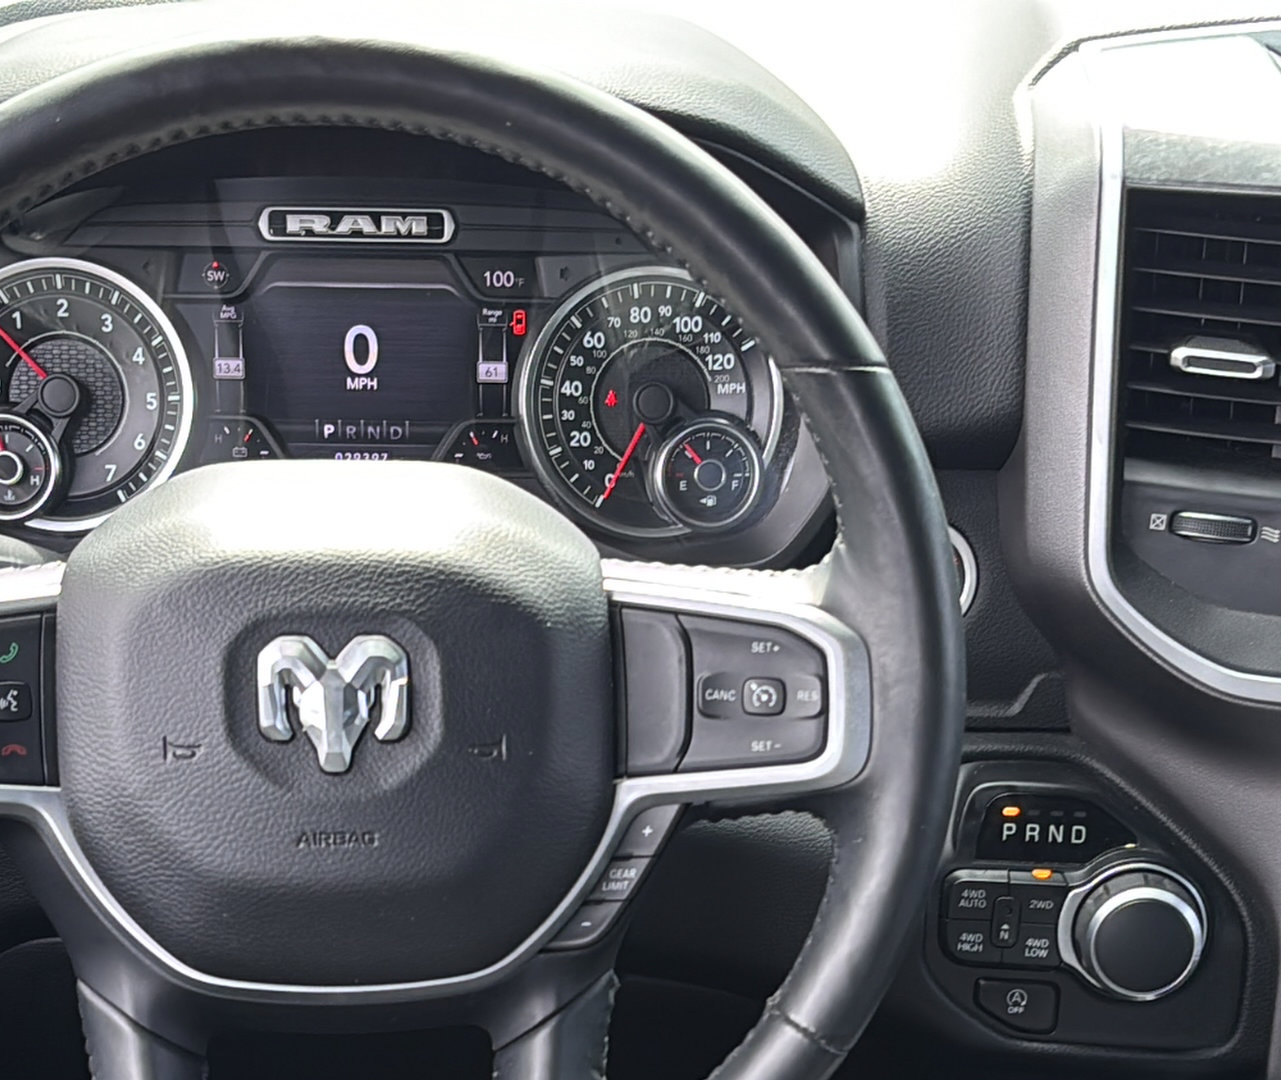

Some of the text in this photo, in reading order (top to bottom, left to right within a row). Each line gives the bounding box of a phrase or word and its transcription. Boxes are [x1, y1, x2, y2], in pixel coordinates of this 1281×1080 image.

[286, 214, 427, 236] RAM
[207, 270, 225, 282] SW
[56, 299, 69, 317] 2
[658, 305, 672, 316] 90
[12, 311, 22, 329] 1
[630, 306, 651, 323] 80
[101, 314, 112, 332] 3
[608, 317, 620, 328] 70
[673, 316, 702, 332] 100
[624, 330, 638, 338] 120
[650, 327, 664, 336] 140
[583, 331, 605, 348] 60
[679, 334, 692, 342] 160
[703, 332, 721, 343] 110
[344, 324, 378, 374] 0
[593, 350, 607, 358] 100
[696, 346, 710, 354] 180
[132, 348, 145, 364] 4
[570, 355, 584, 366] 50
[705, 353, 735, 370] 120
[217, 363, 241, 374] 13.4
[485, 367, 498, 377] 61
[586, 366, 596, 374] 80
[346, 377, 377, 390] MPH
[714, 375, 729, 383] 200
[561, 380, 582, 396] 40
[717, 382, 746, 394] MPH
[146, 393, 157, 410] 5
[578, 396, 588, 404] 60
[561, 410, 575, 420] 30
[582, 421, 591, 429] 40
[324, 424, 401, 439] P R N D
[133, 433, 146, 450] 6
[501, 434, 508, 443] H
[570, 431, 591, 447] 20
[594, 446, 604, 454] 20
[583, 460, 595, 470] 10
[105, 465, 117, 481] 7
[30, 475, 40, 485] H
[679, 480, 687, 490] E
[732, 480, 739, 490] F
[705, 689, 736, 701] CANC
[797, 690, 818, 701] RES
[1002, 822, 1086, 843] P R N D
[296, 831, 380, 848] AIRBAG
[609, 868, 636, 879] GEAR
[602, 880, 629, 891] LIMIT
[962, 889, 986, 898] 4WD
[959, 899, 986, 908] AUTO
[1029, 899, 1054, 909] 2WD
[960, 932, 983, 942] 4WD
[1026, 938, 1049, 947] 4WD
[957, 942, 983, 952] HIGH
[1025, 948, 1048, 957] LOW
[1008, 1006, 1024, 1014] OFF
